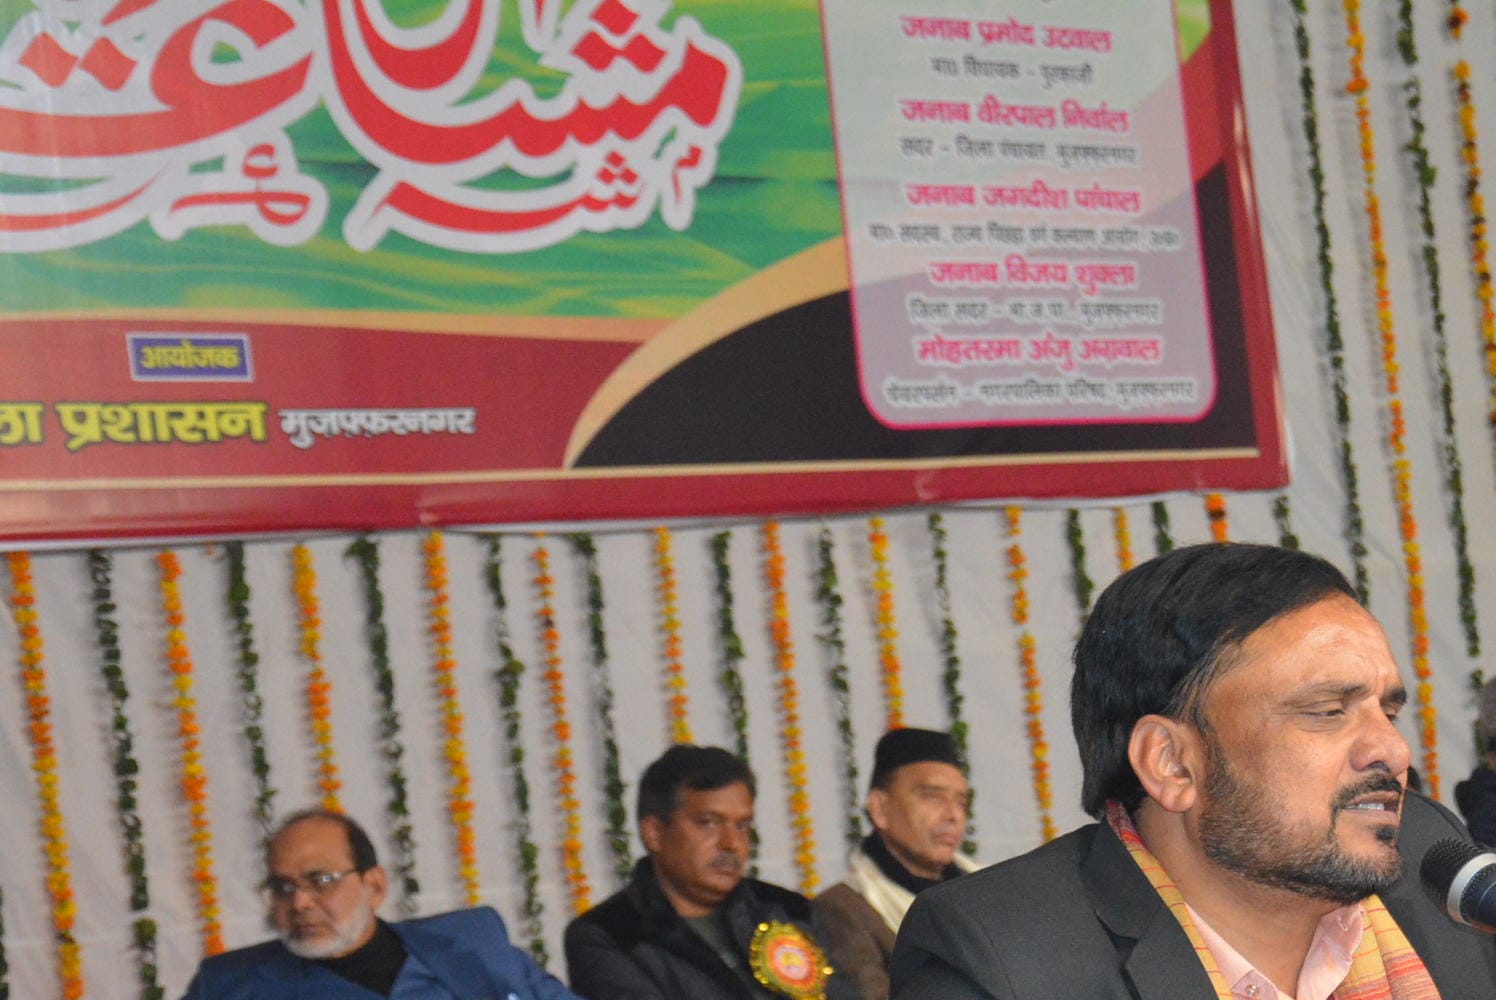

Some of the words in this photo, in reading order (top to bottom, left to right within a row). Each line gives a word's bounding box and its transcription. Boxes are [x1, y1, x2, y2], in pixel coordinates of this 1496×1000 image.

[901, 16, 971, 40] जनाब
[900, 100, 971, 123] जनाब
[906, 185, 975, 205] जनाब
[929, 262, 998, 283] जनाब
[141, 338, 239, 369] आयोजक
[55, 402, 267, 452] प्रशासन
